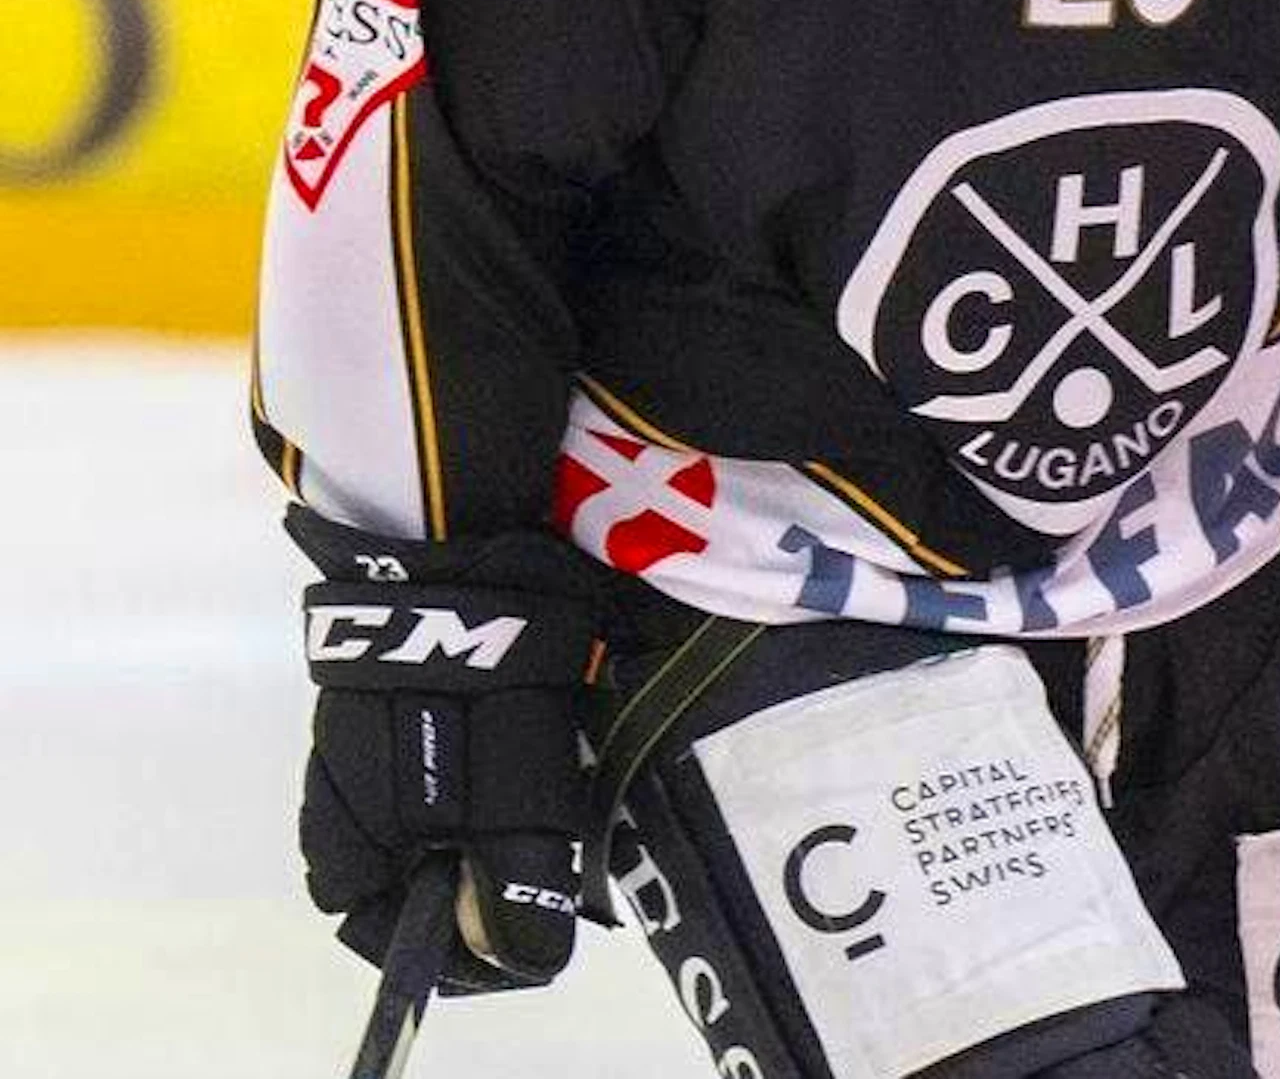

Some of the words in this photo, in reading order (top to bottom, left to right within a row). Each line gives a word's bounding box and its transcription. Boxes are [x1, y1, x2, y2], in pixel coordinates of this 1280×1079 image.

[957, 399, 1184, 490] LUGANO
[891, 759, 1028, 812] CAPITAL
[904, 780, 1084, 845] STRATEGIES
[918, 812, 1076, 876] PARTNERS
[930, 851, 1048, 907] SWISS
